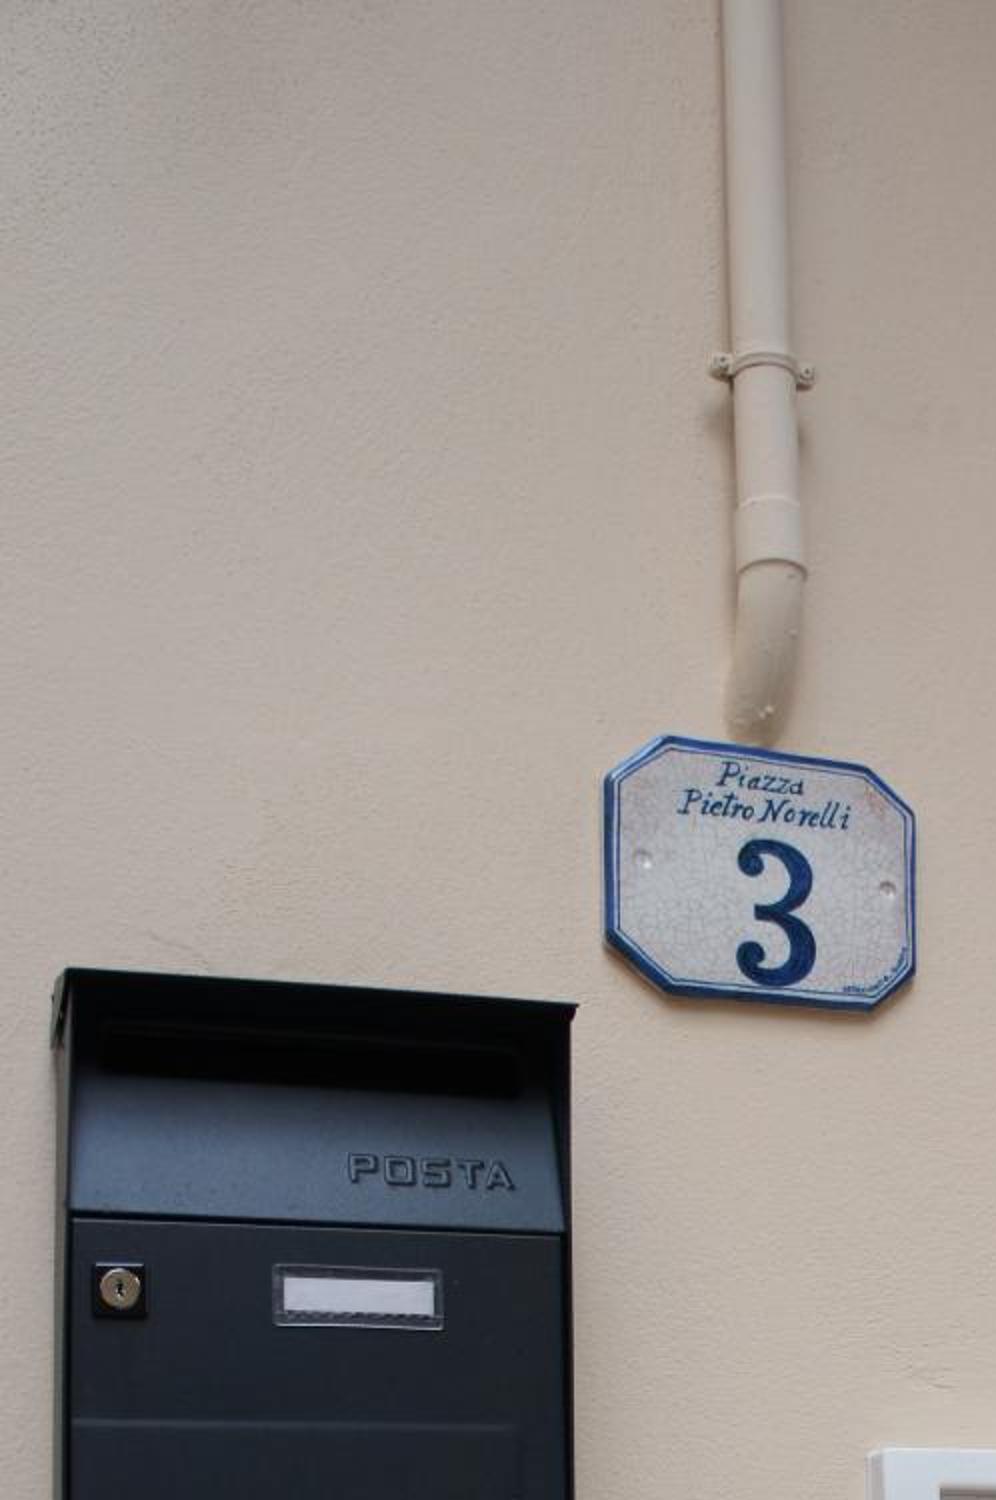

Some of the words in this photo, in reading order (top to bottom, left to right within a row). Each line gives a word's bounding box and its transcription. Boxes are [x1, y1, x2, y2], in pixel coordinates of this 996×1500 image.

[716, 761, 804, 795] Piazza
[677, 788, 754, 821] Pietro
[758, 798, 852, 830] Norelli
[737, 839, 816, 987] 3
[348, 1153, 516, 1191] POSTA
